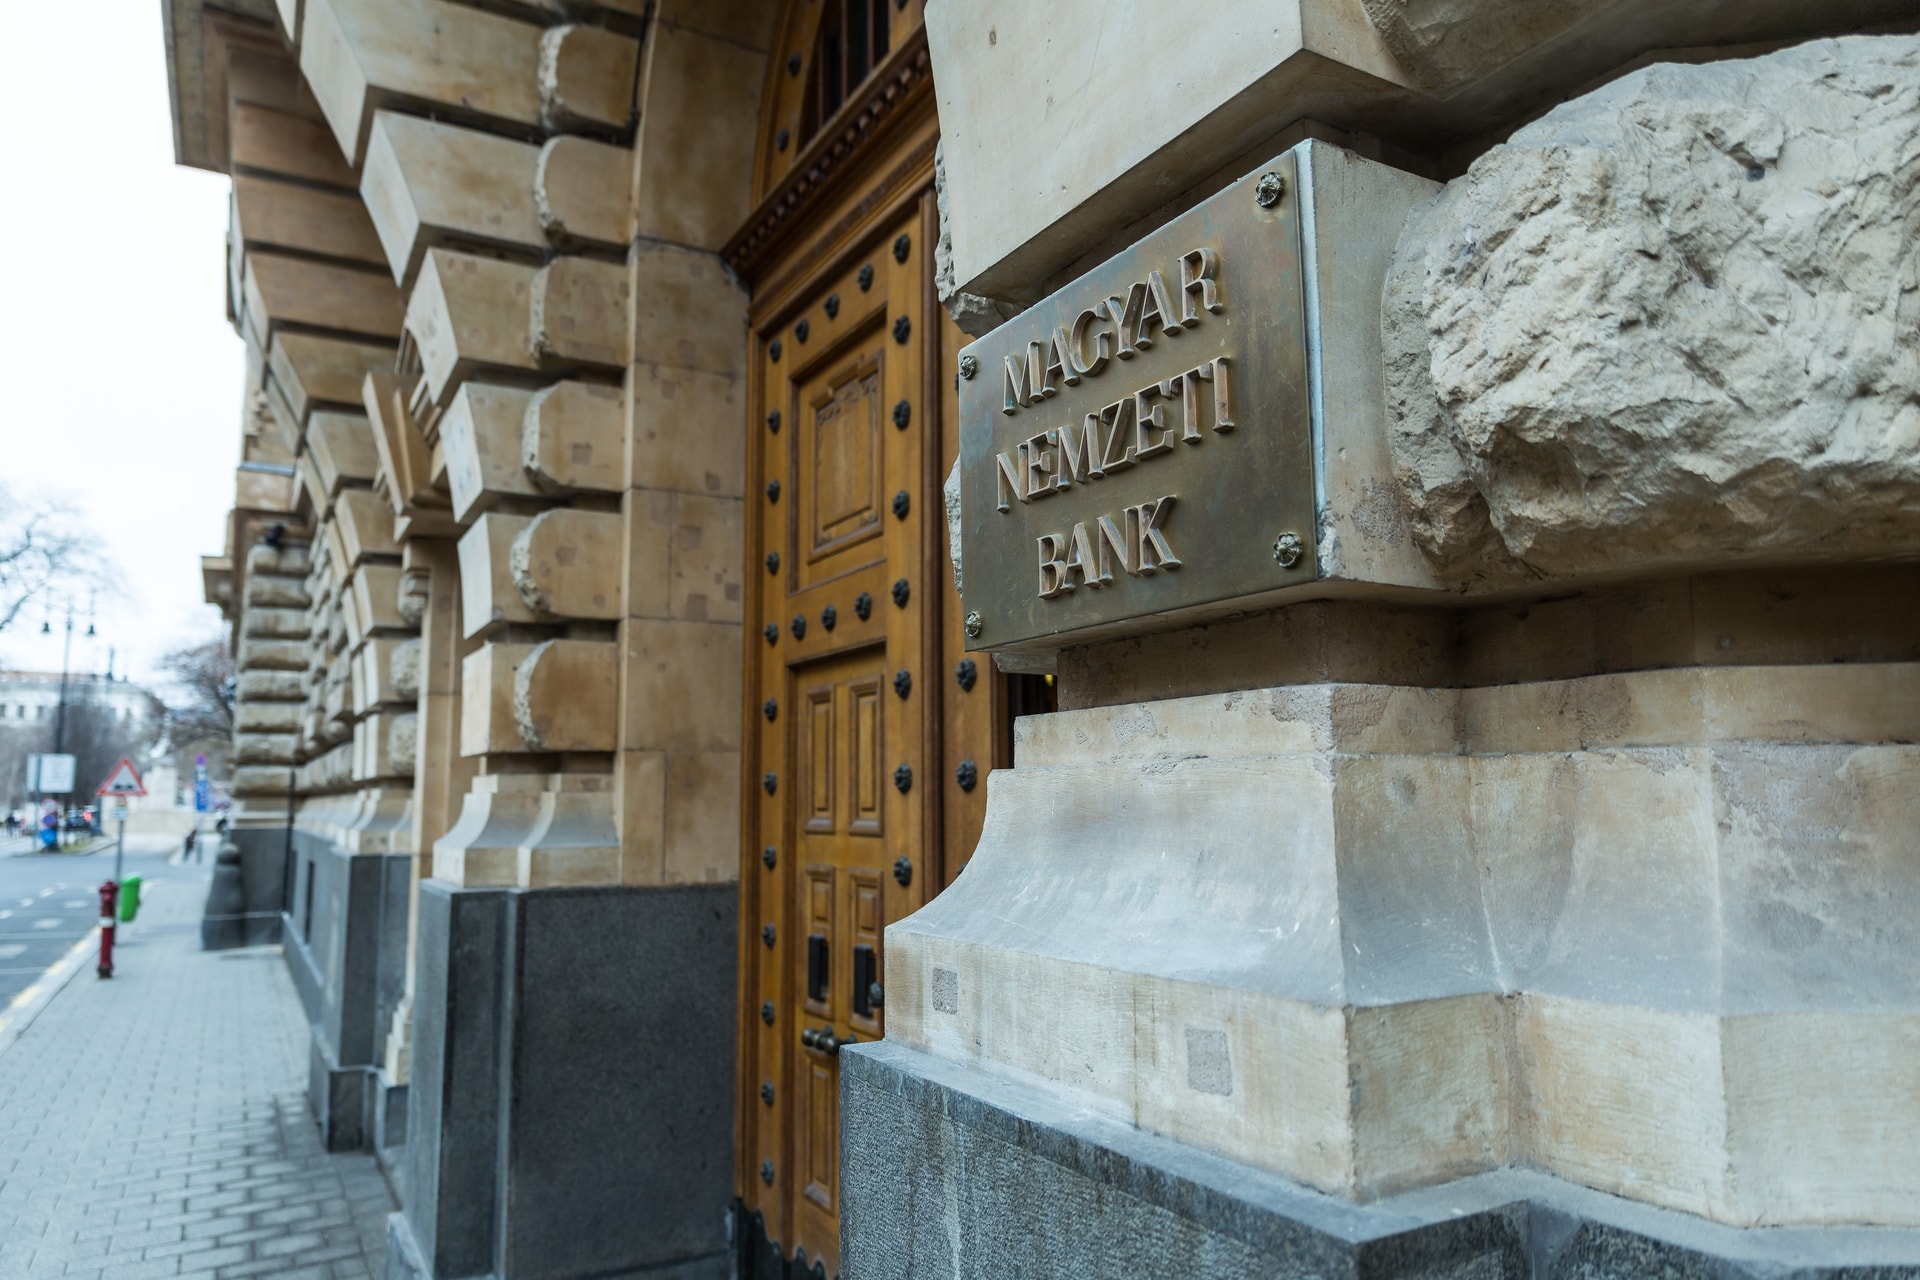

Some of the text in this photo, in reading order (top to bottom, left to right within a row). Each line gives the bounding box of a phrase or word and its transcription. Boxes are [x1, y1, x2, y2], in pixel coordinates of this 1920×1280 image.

[1002, 248, 1223, 415] MAGYAR
[995, 356, 1235, 513] NEMZETI
[1036, 495, 1183, 600] BANK
